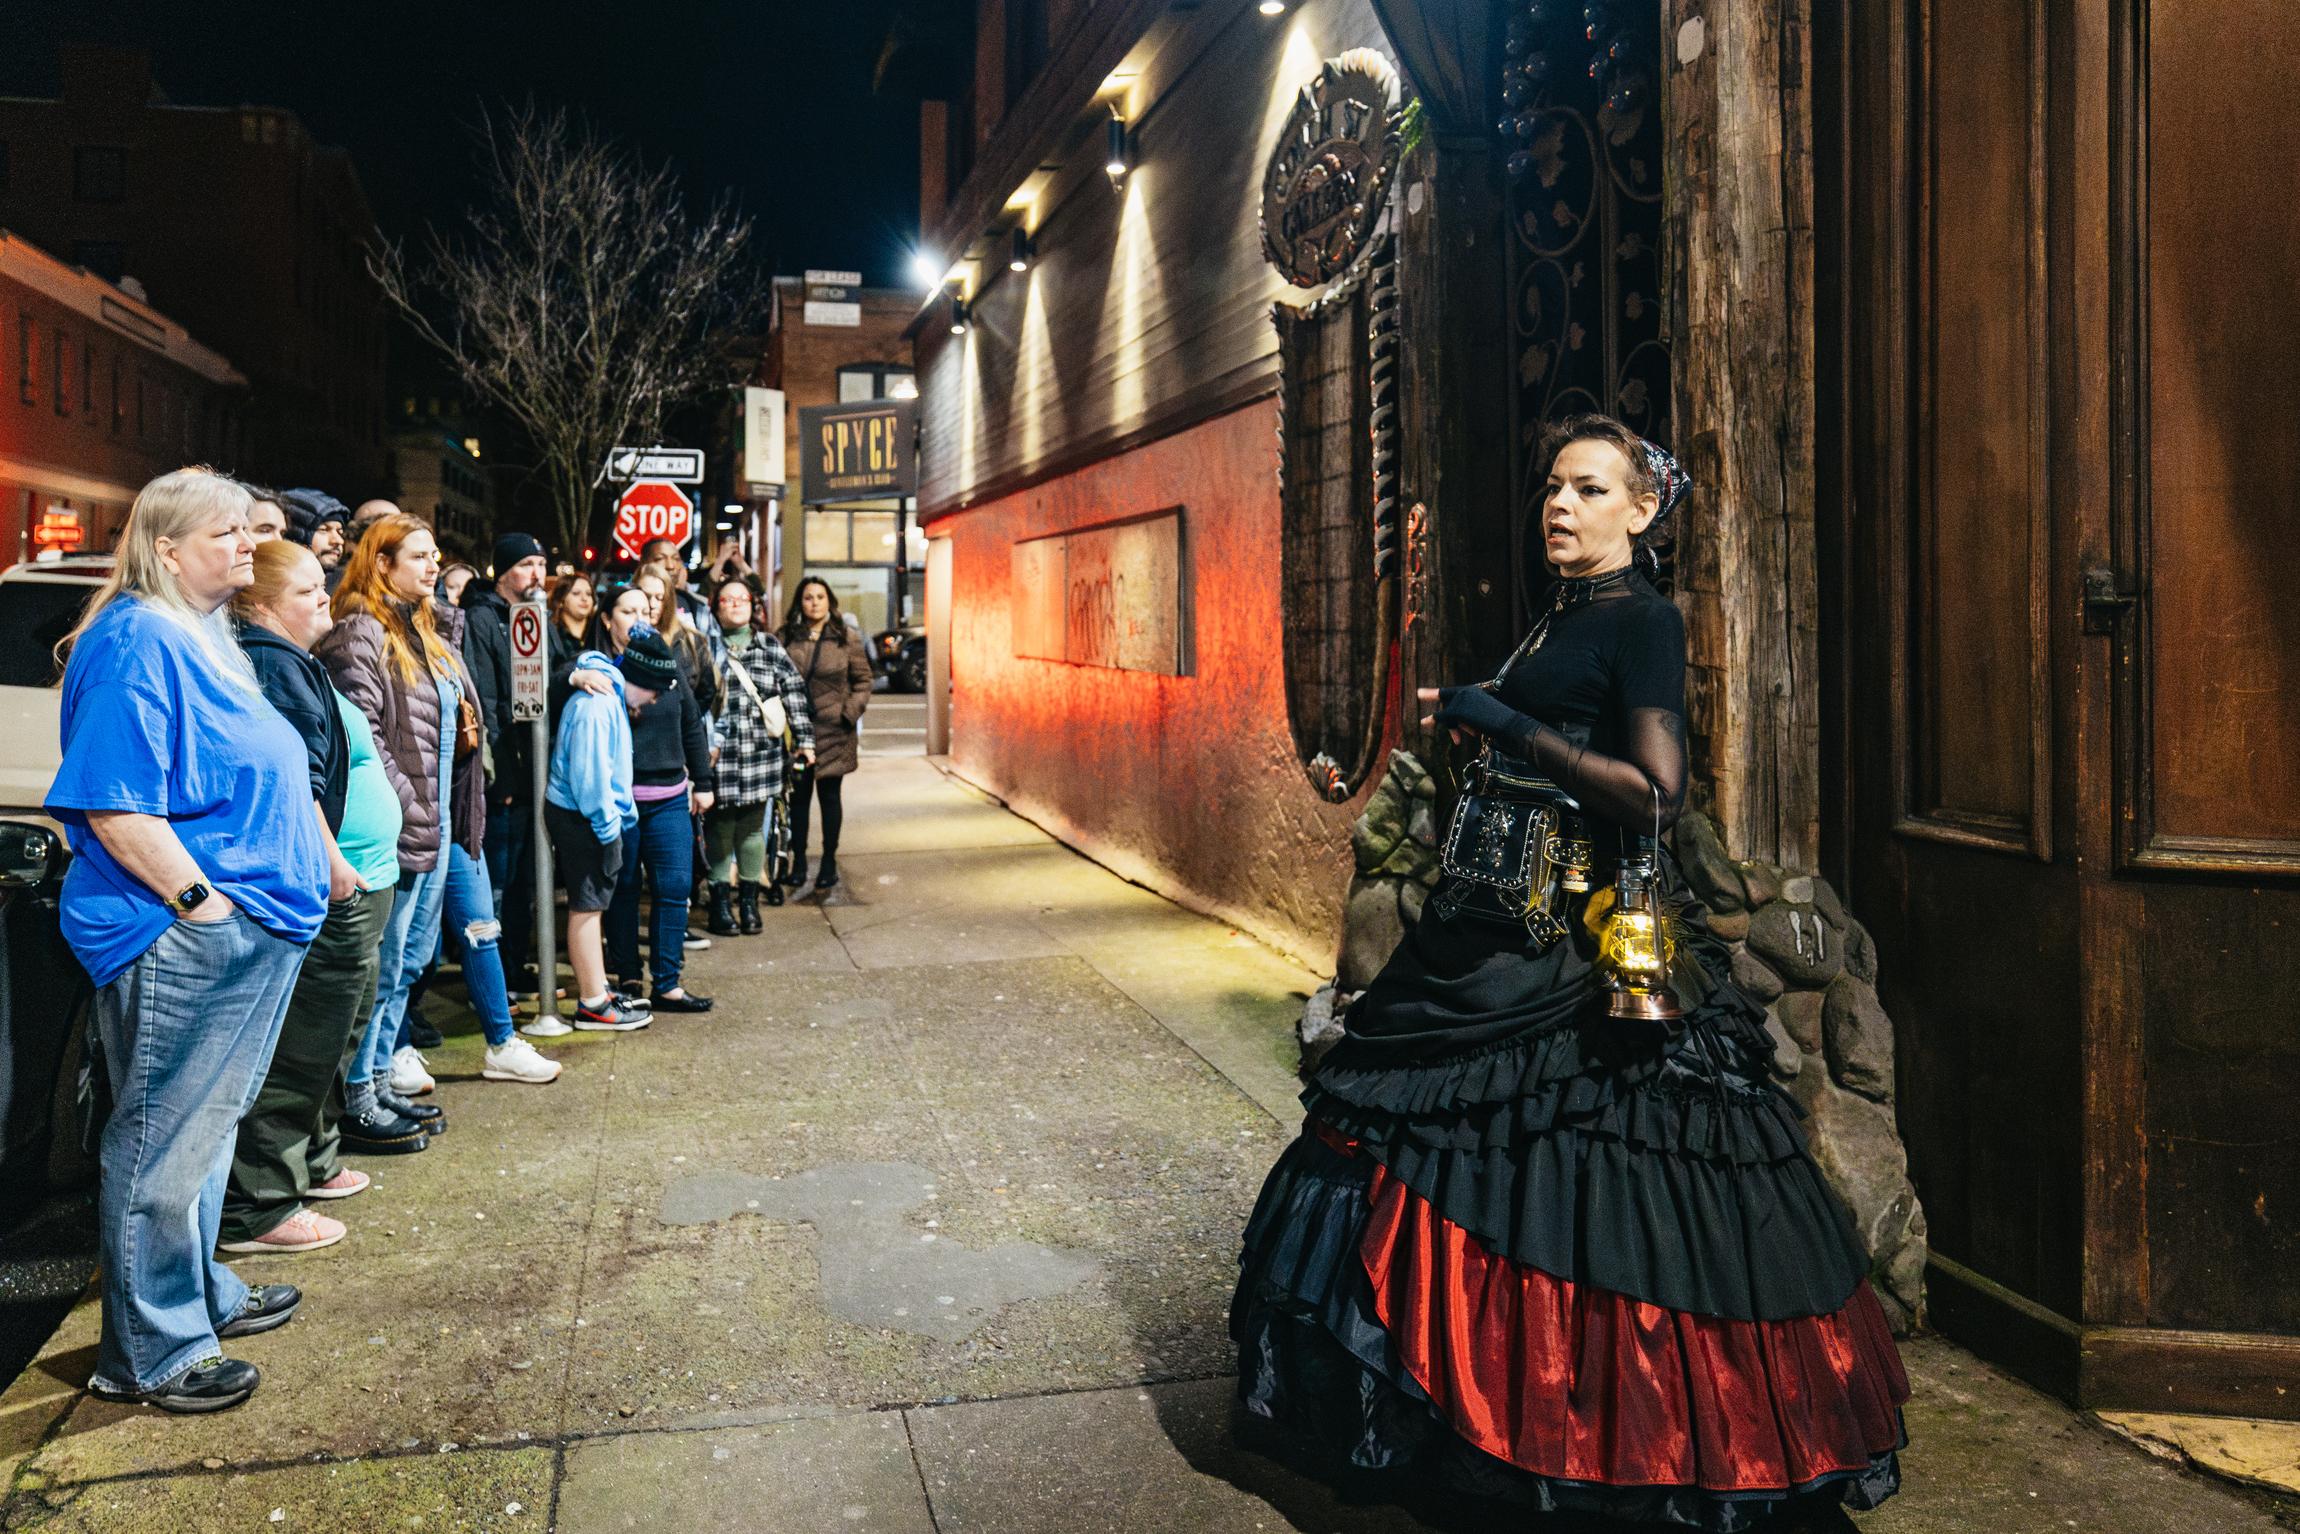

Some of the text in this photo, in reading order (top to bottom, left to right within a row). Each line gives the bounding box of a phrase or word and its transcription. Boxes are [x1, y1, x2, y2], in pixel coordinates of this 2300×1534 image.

[822, 416, 898, 474] SPYCE
[667, 461, 689, 471] WAY
[619, 504, 687, 536] STOP
[517, 681, 538, 693] FRI-SAT
